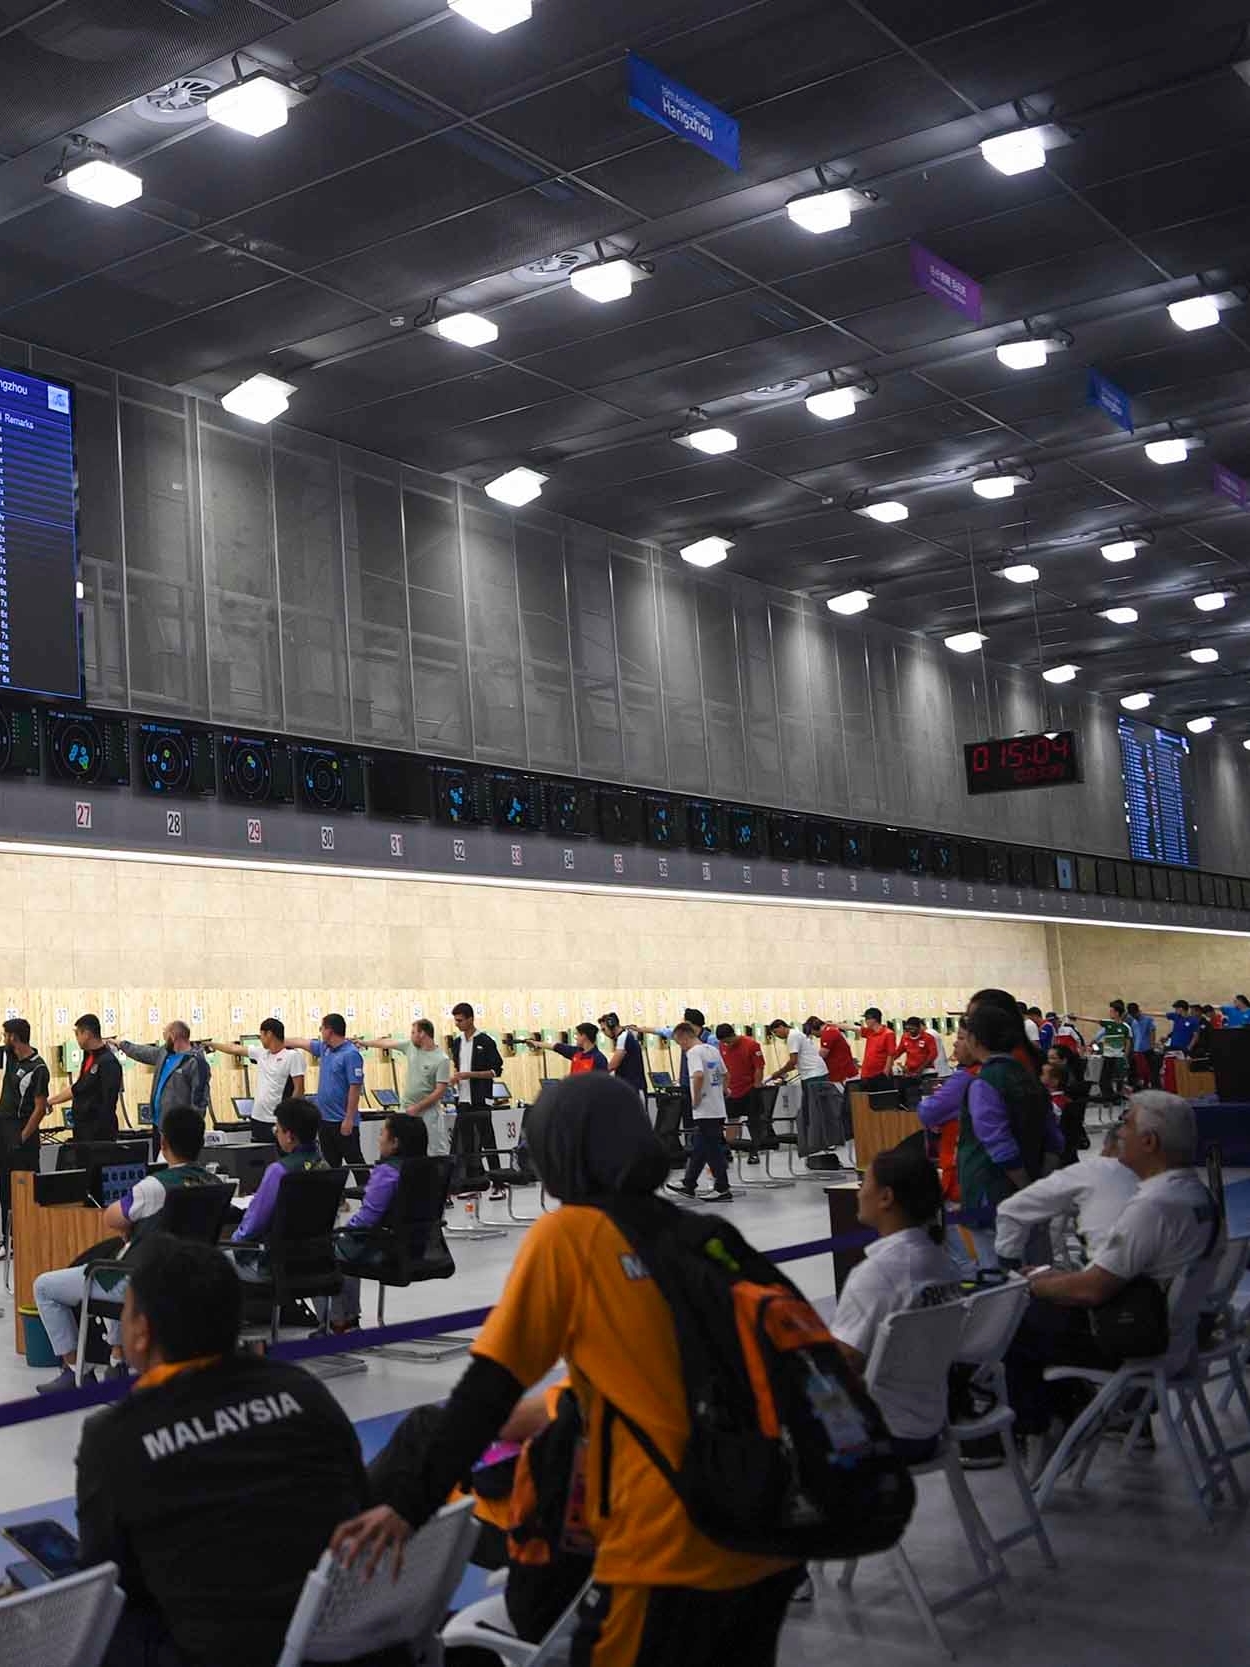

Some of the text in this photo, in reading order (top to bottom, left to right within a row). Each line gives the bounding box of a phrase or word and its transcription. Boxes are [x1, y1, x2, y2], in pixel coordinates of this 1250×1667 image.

[662, 97, 714, 142] Hangzhou
[4, 414, 34, 430] Remarks
[77, 804, 91, 825] 27
[168, 813, 180, 833] 28
[248, 820, 261, 841] 29
[322, 829, 334, 848] 30
[391, 835, 402, 855] 31
[454, 841, 465, 859] 32
[105, 1010, 114, 1022] 38
[507, 1123, 515, 1138] 33
[142, 1391, 303, 1461] MALAYSIA
